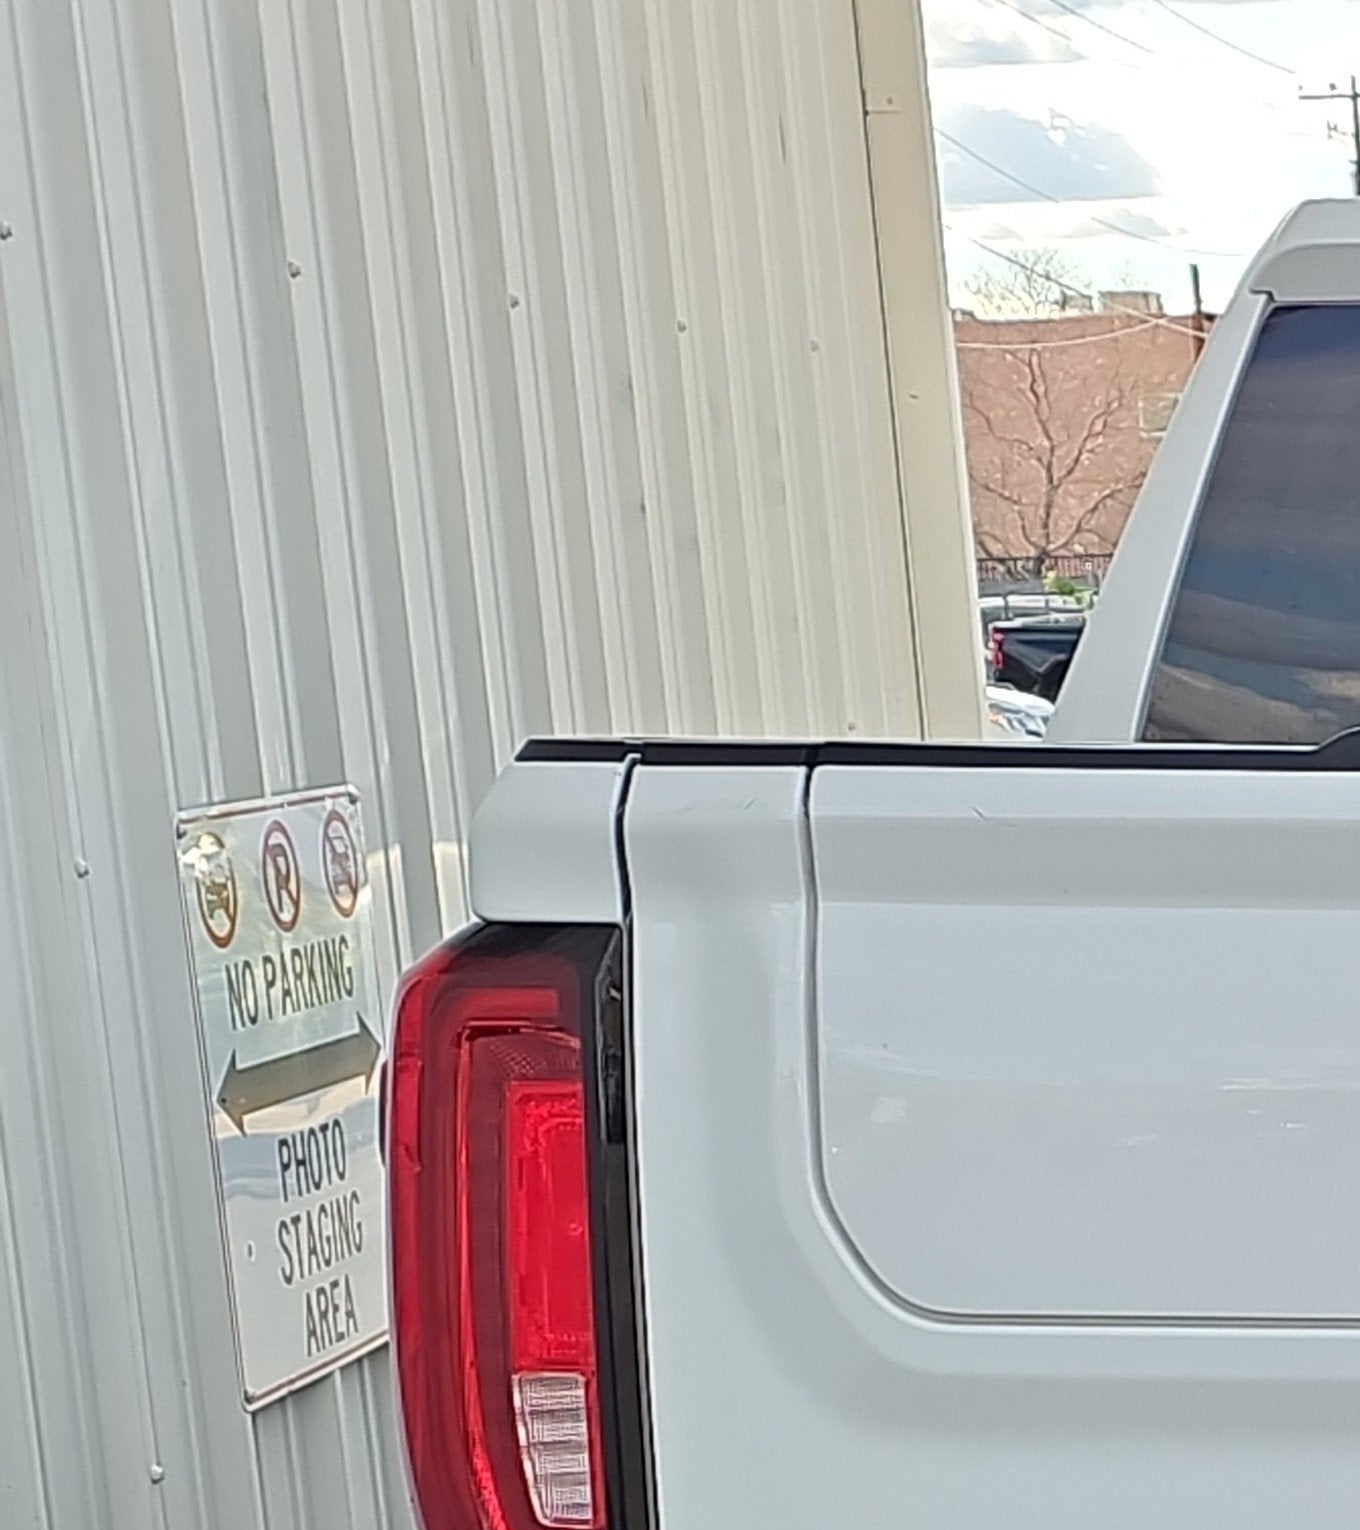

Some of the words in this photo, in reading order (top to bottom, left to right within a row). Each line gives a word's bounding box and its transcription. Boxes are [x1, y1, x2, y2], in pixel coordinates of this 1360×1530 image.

[225, 959, 258, 1031] NO
[262, 934, 354, 1020] PARKING
[278, 1118, 346, 1202] PHOTO
[278, 1190, 362, 1285] STAGING
[306, 1273, 359, 1357] AREA
